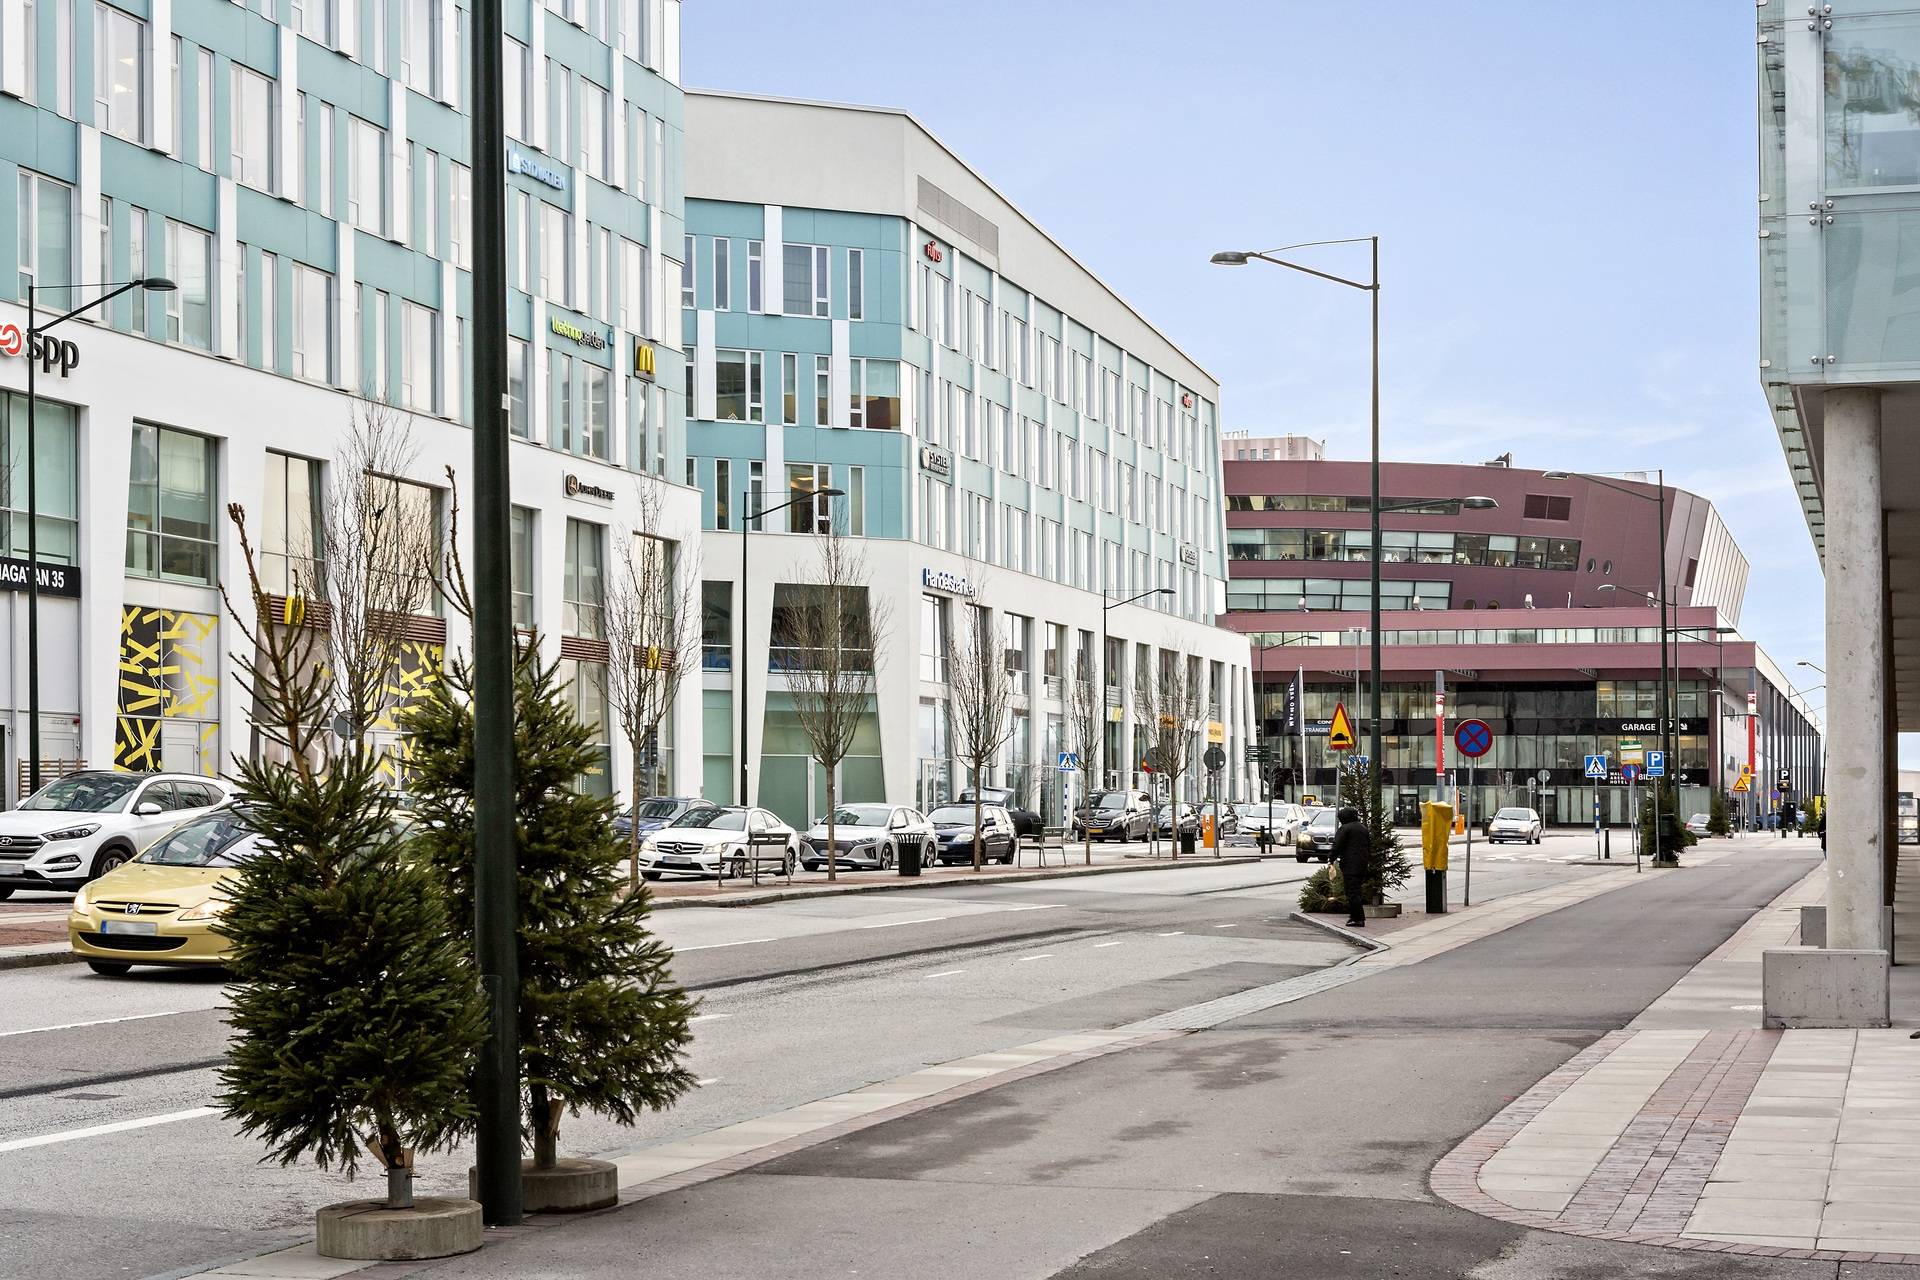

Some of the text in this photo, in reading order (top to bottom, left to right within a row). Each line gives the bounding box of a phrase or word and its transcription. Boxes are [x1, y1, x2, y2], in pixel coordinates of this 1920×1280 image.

[51, 570, 65, 588] 35
[922, 567, 977, 597] Handelsbanken
[1621, 723, 1656, 731] GARAGE
[1651, 753, 1661, 766] P
[1781, 770, 1789, 779] P
